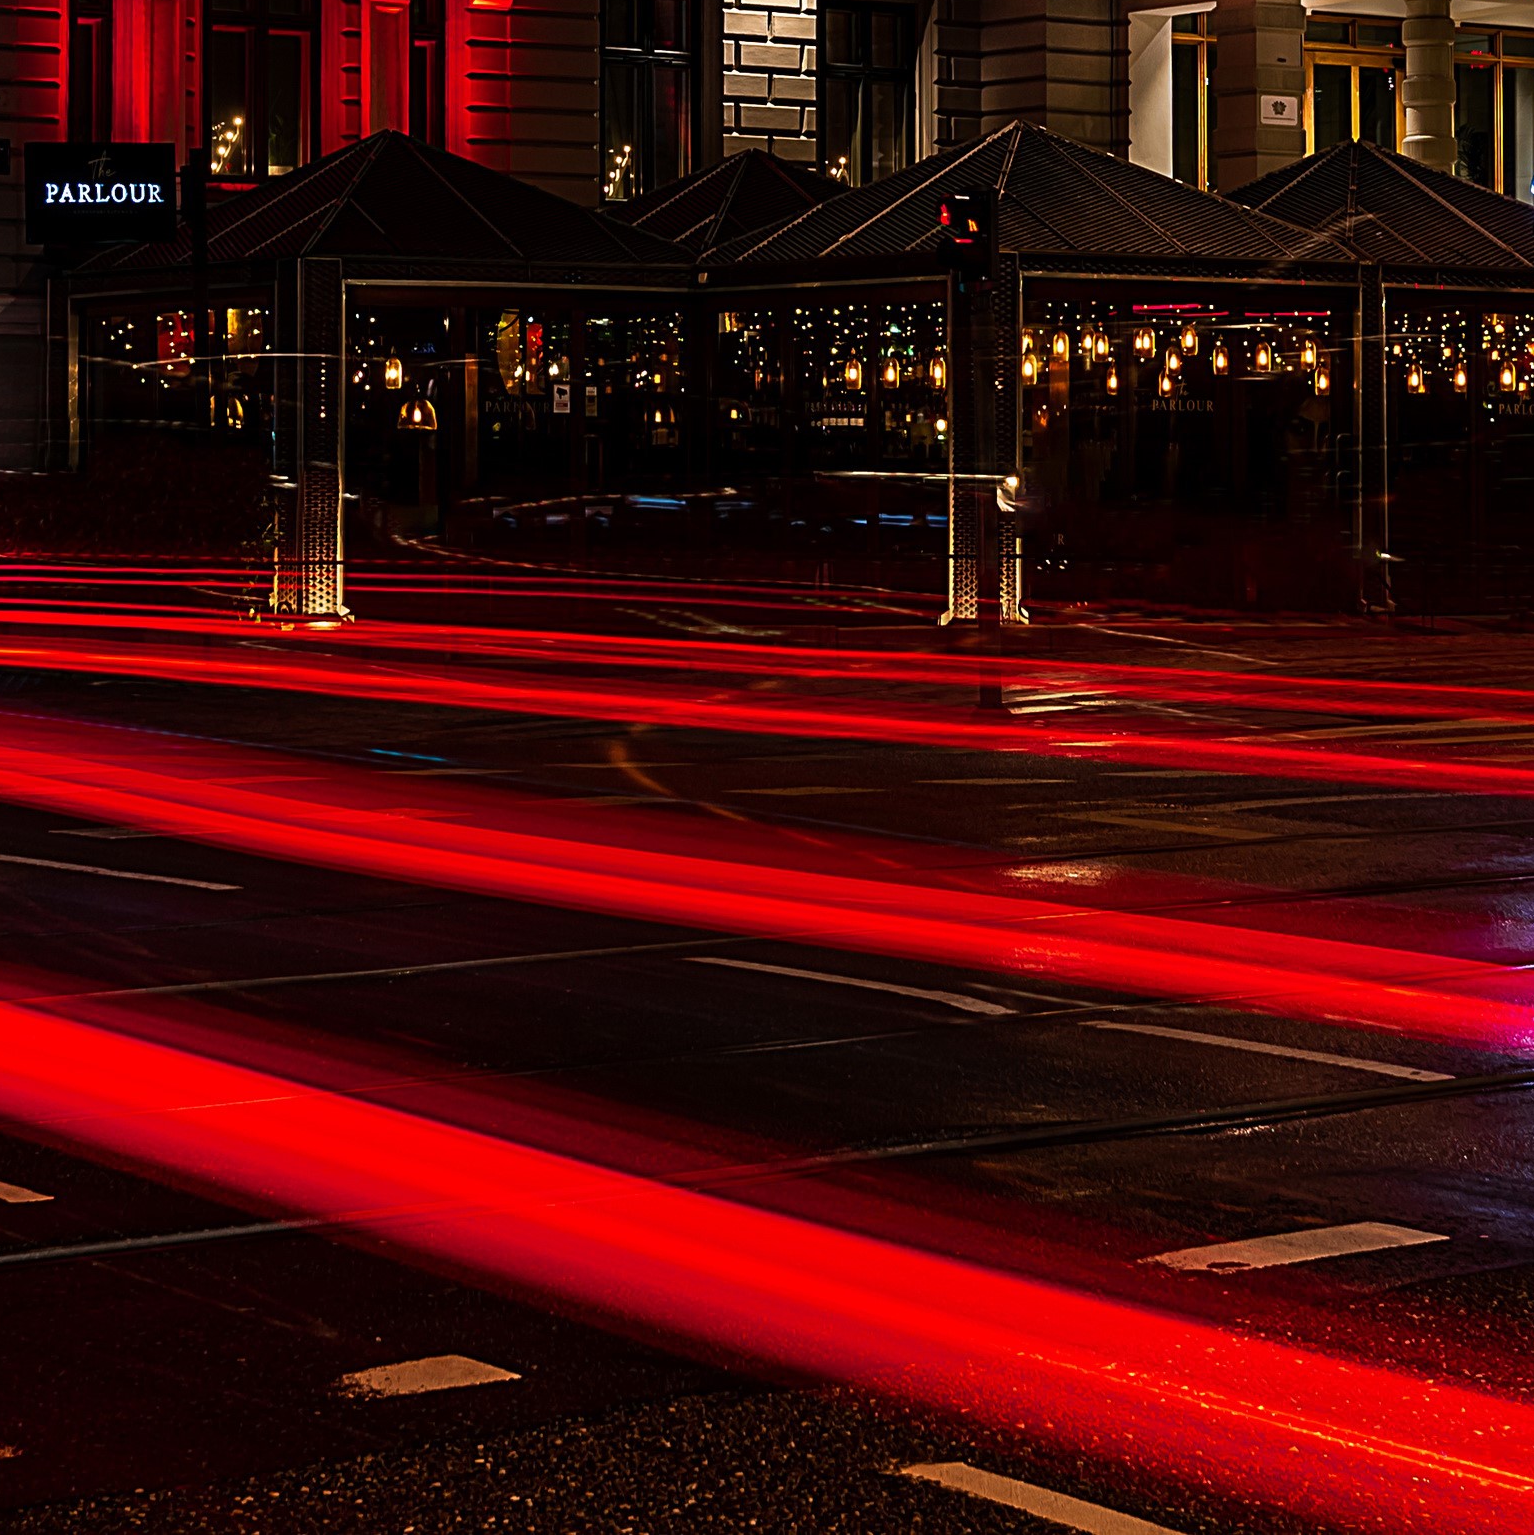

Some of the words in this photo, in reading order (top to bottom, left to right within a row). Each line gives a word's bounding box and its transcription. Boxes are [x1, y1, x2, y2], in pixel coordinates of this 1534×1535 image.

[87, 150, 116, 182] The
[45, 182, 165, 205] PARLOUR
[1152, 399, 1215, 412] PARLOUR
